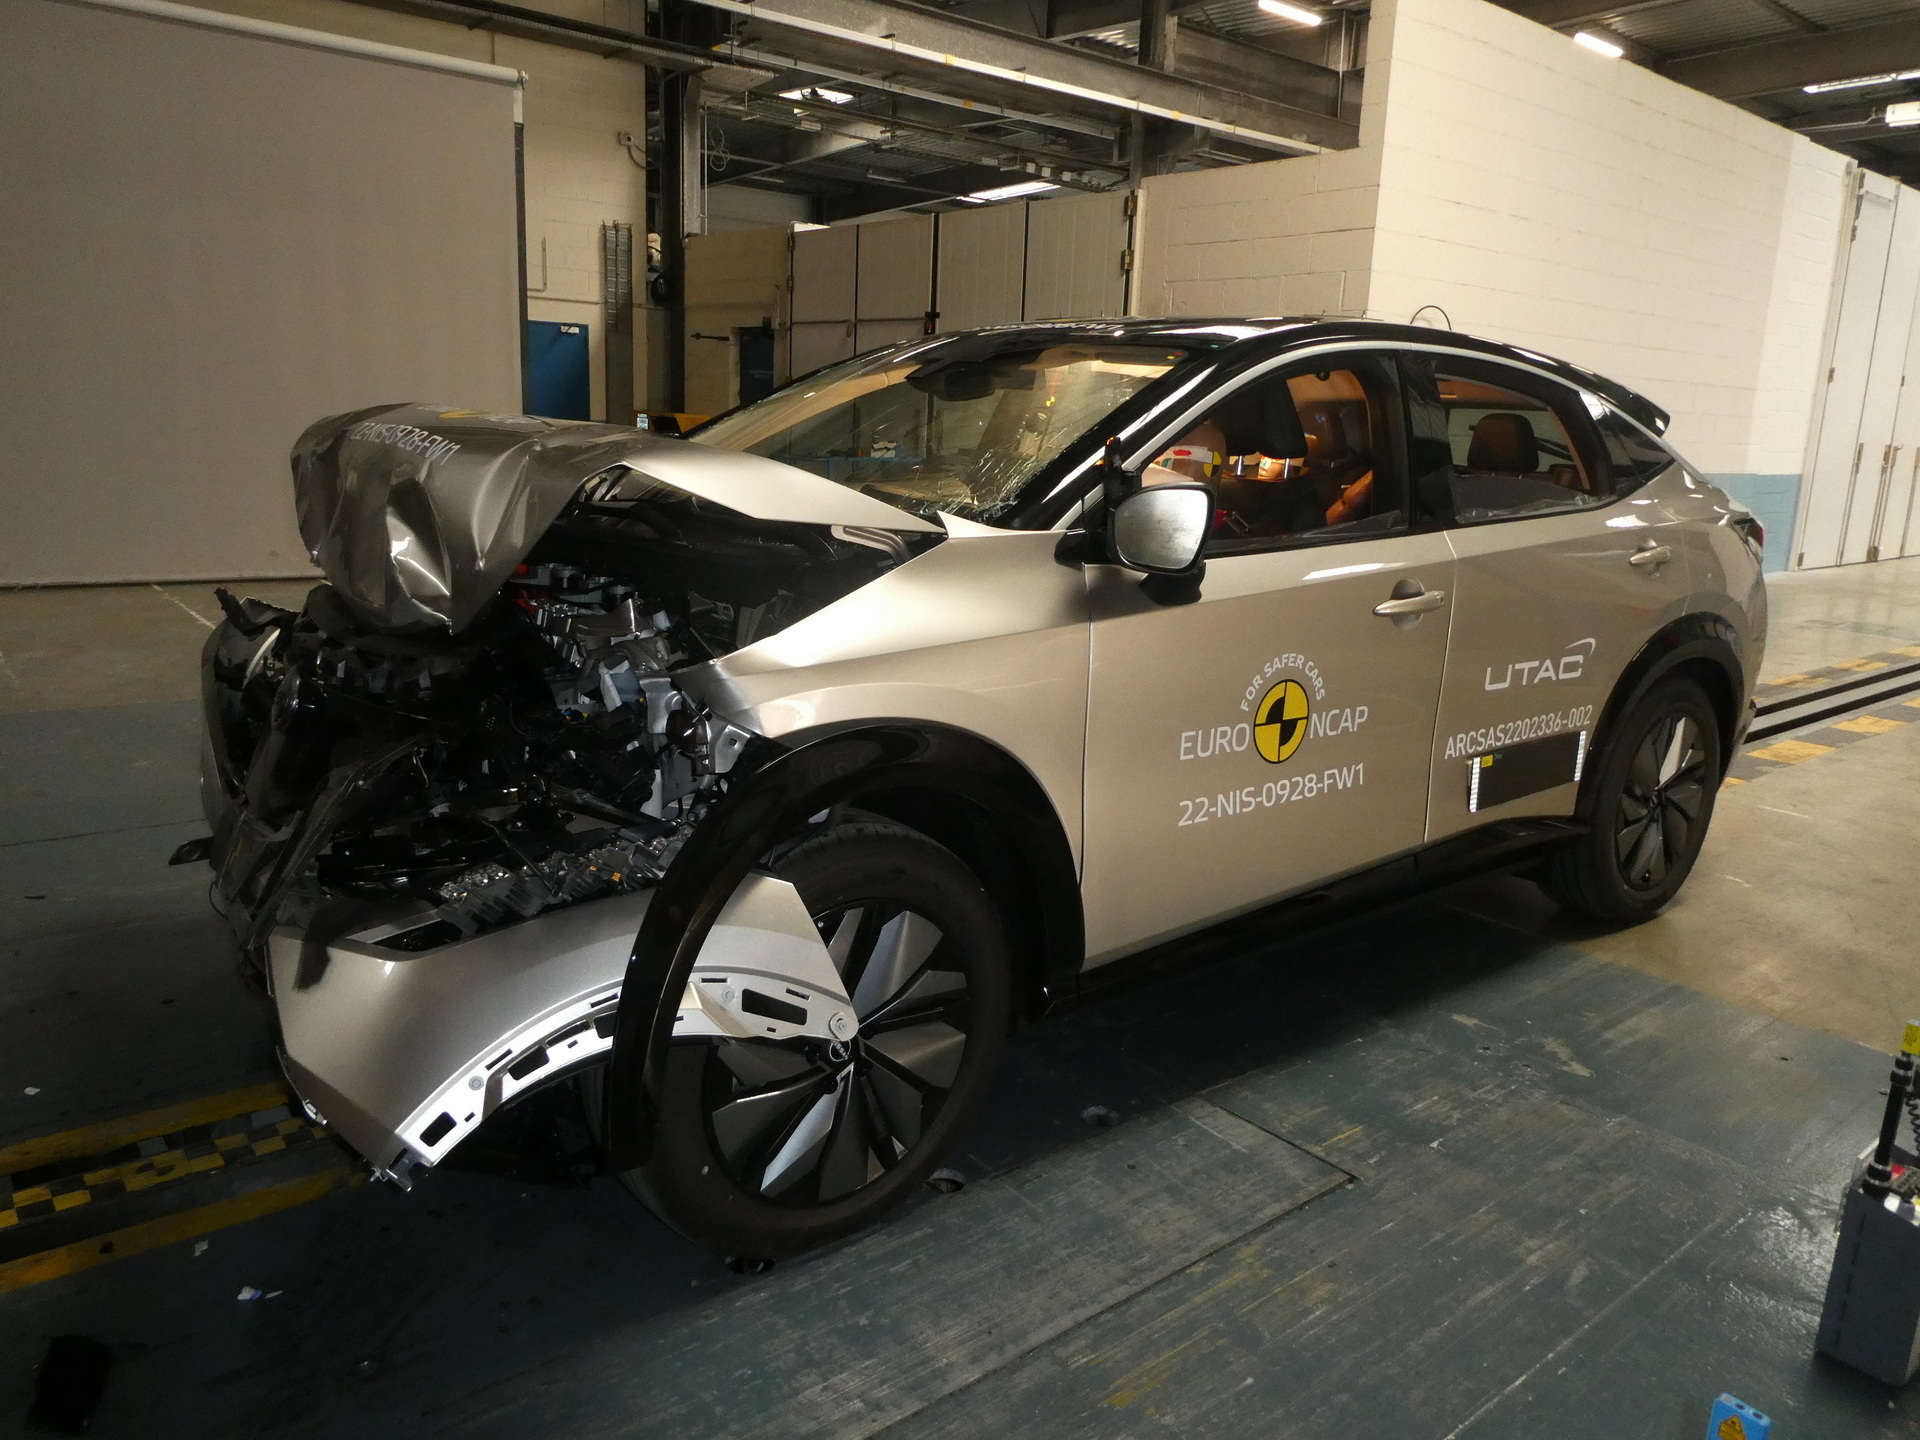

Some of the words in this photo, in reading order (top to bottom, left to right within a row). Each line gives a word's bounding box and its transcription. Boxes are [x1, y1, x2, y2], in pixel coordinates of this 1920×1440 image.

[350, 422, 462, 466] 22-NIS-0928-FW1
[1240, 674, 1264, 711] FOR
[1264, 653, 1305, 677] SAFER
[1305, 661, 1326, 701] CARS
[1484, 654, 1584, 691] UTAC
[1179, 722, 1250, 760] EURO
[1309, 705, 1368, 739] NCAP
[1444, 704, 1593, 759] ARCSAS2202336-002
[1177, 762, 1364, 827] 22-NIS-0928-FW1
